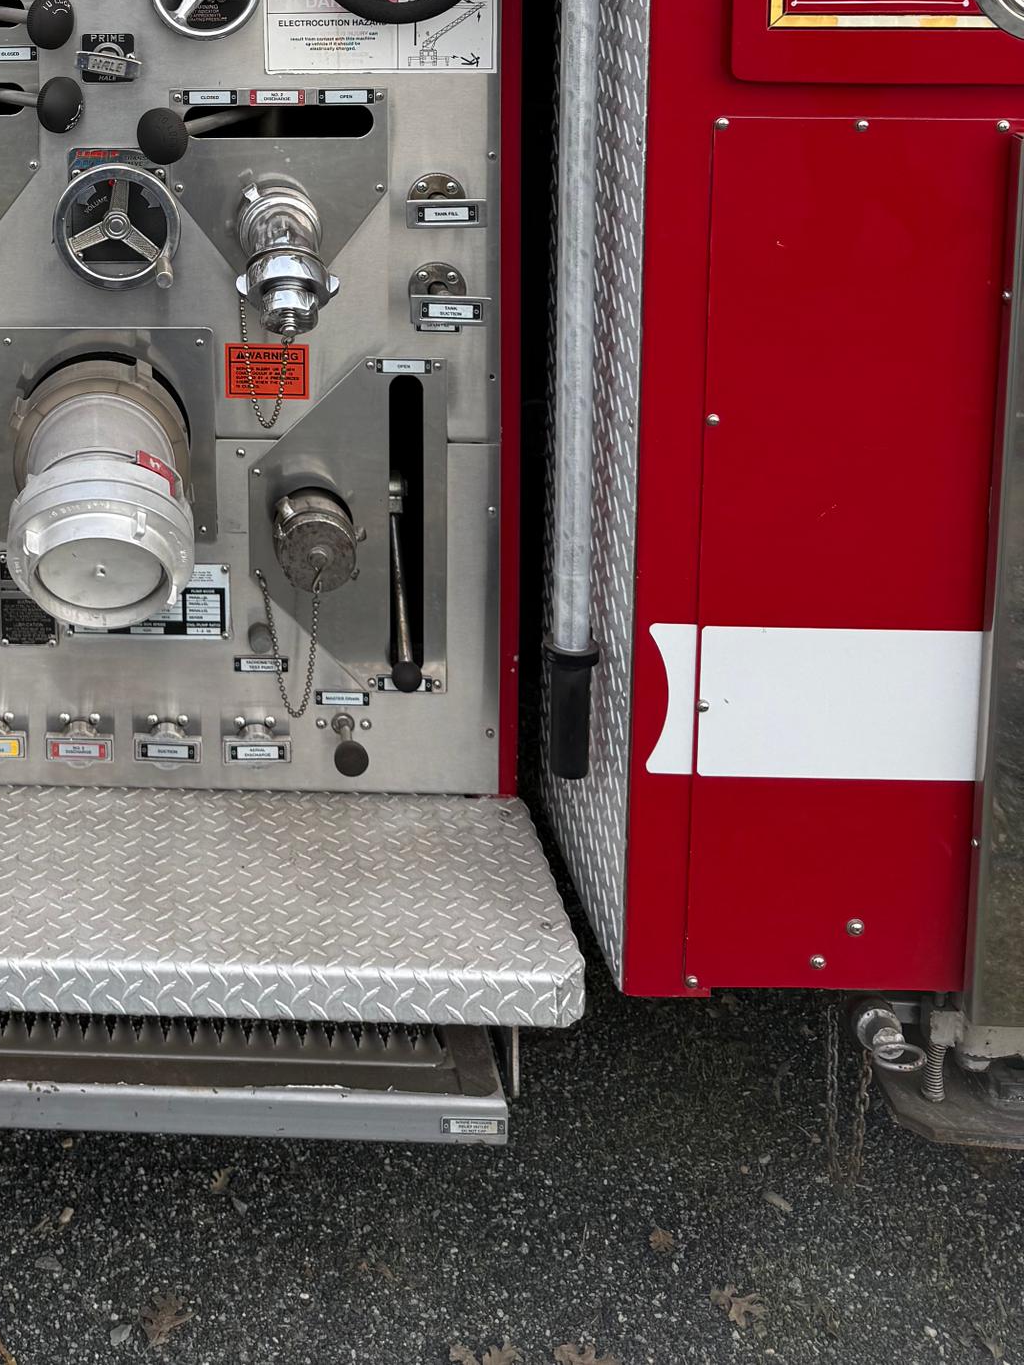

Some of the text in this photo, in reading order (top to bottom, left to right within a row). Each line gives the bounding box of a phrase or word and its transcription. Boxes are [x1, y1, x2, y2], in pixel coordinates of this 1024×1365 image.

[278, 19, 352, 27] ELECTROCUTION
[90, 34, 125, 43] PRIME
[91, 58, 124, 73] HALE
[84, 195, 109, 214] VOLUME
